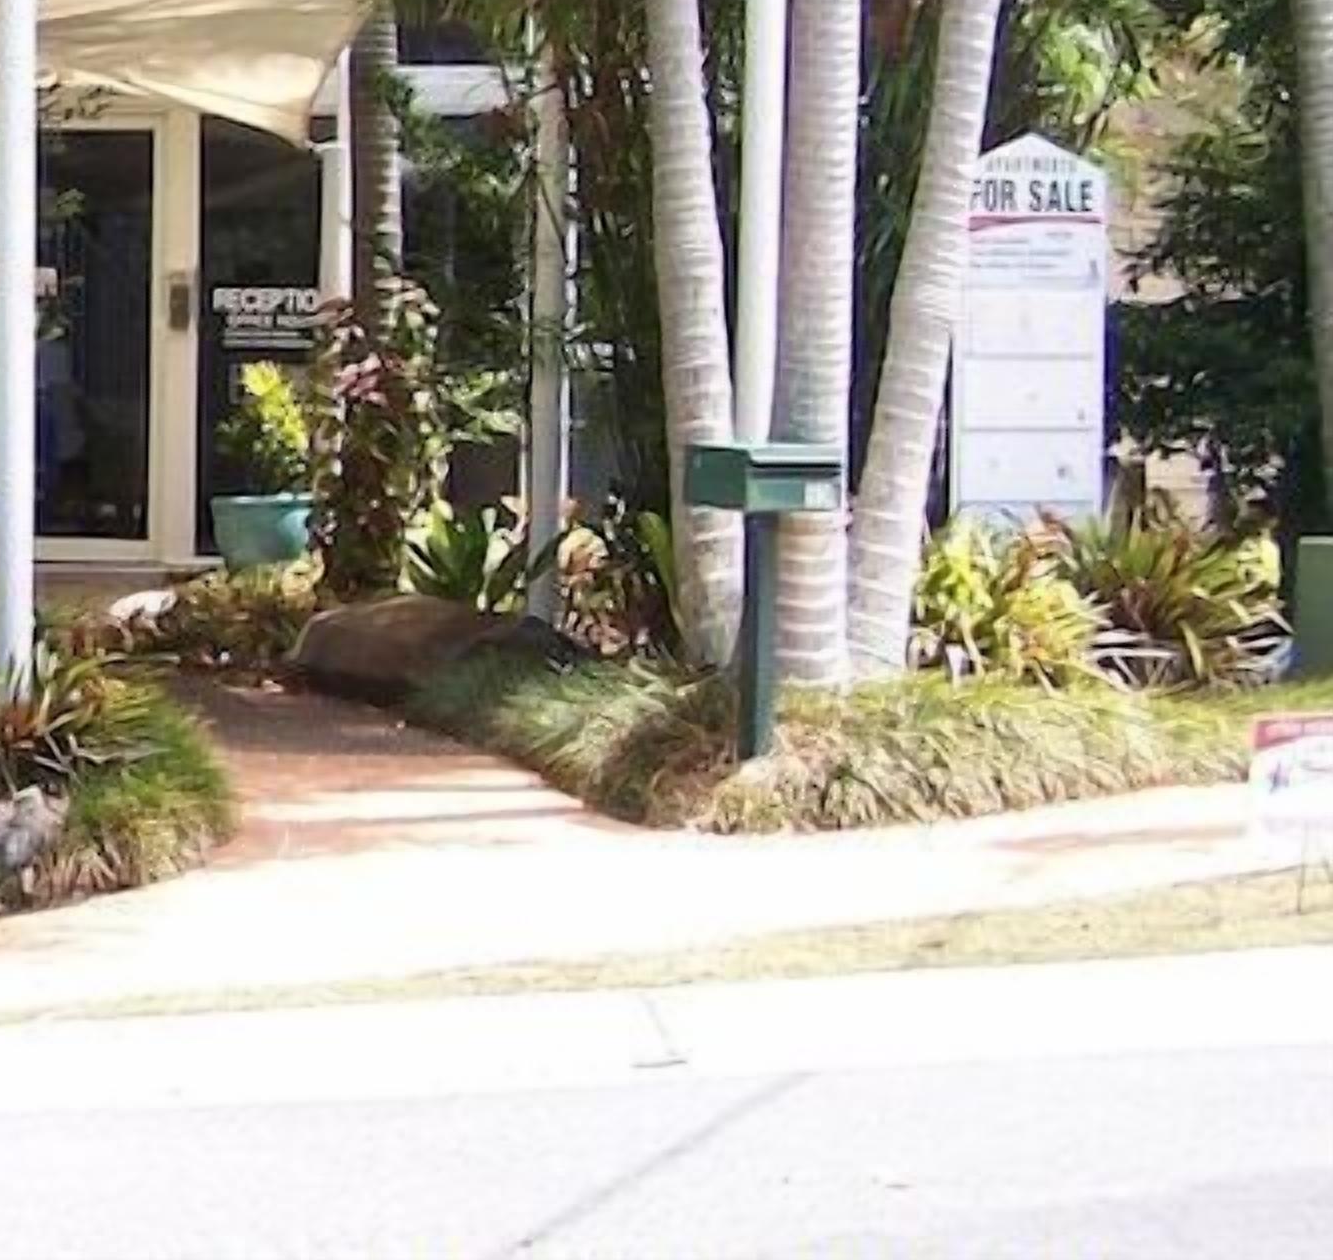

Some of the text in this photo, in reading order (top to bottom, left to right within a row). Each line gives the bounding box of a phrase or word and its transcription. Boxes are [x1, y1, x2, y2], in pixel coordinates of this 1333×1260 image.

[970, 179, 1093, 212] FOR SALE
[214, 288, 317, 313] RECEPTIO
